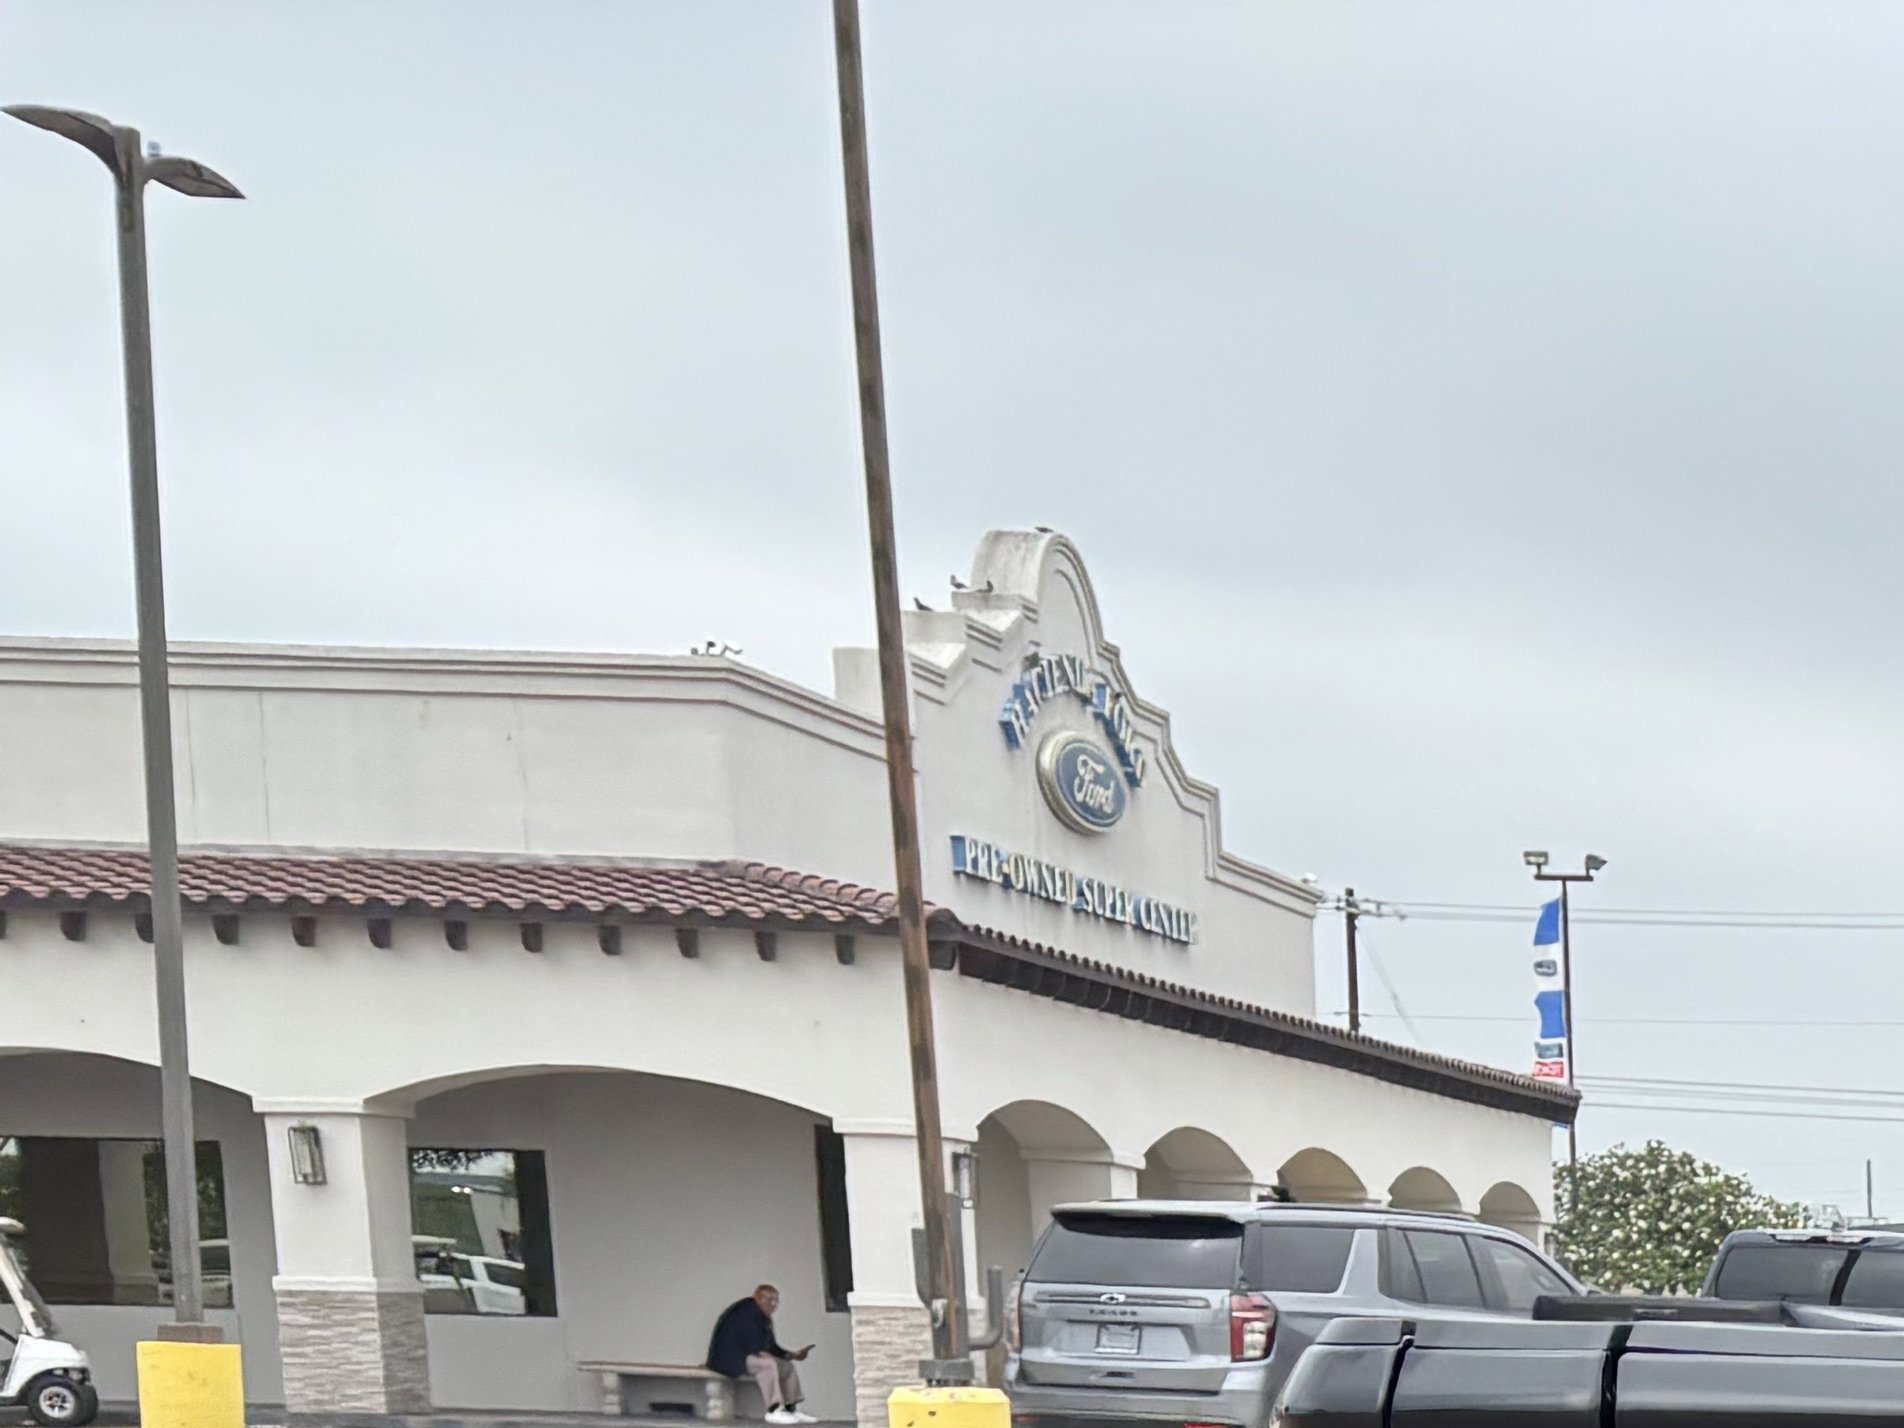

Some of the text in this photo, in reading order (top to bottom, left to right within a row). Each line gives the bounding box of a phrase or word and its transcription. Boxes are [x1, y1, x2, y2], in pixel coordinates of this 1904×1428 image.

[1000, 656, 1099, 752] HACIEN
[1073, 754, 1115, 814] Ford
[953, 835, 1077, 907] PRE-OWNED
[1077, 877, 1137, 926] SUPER
